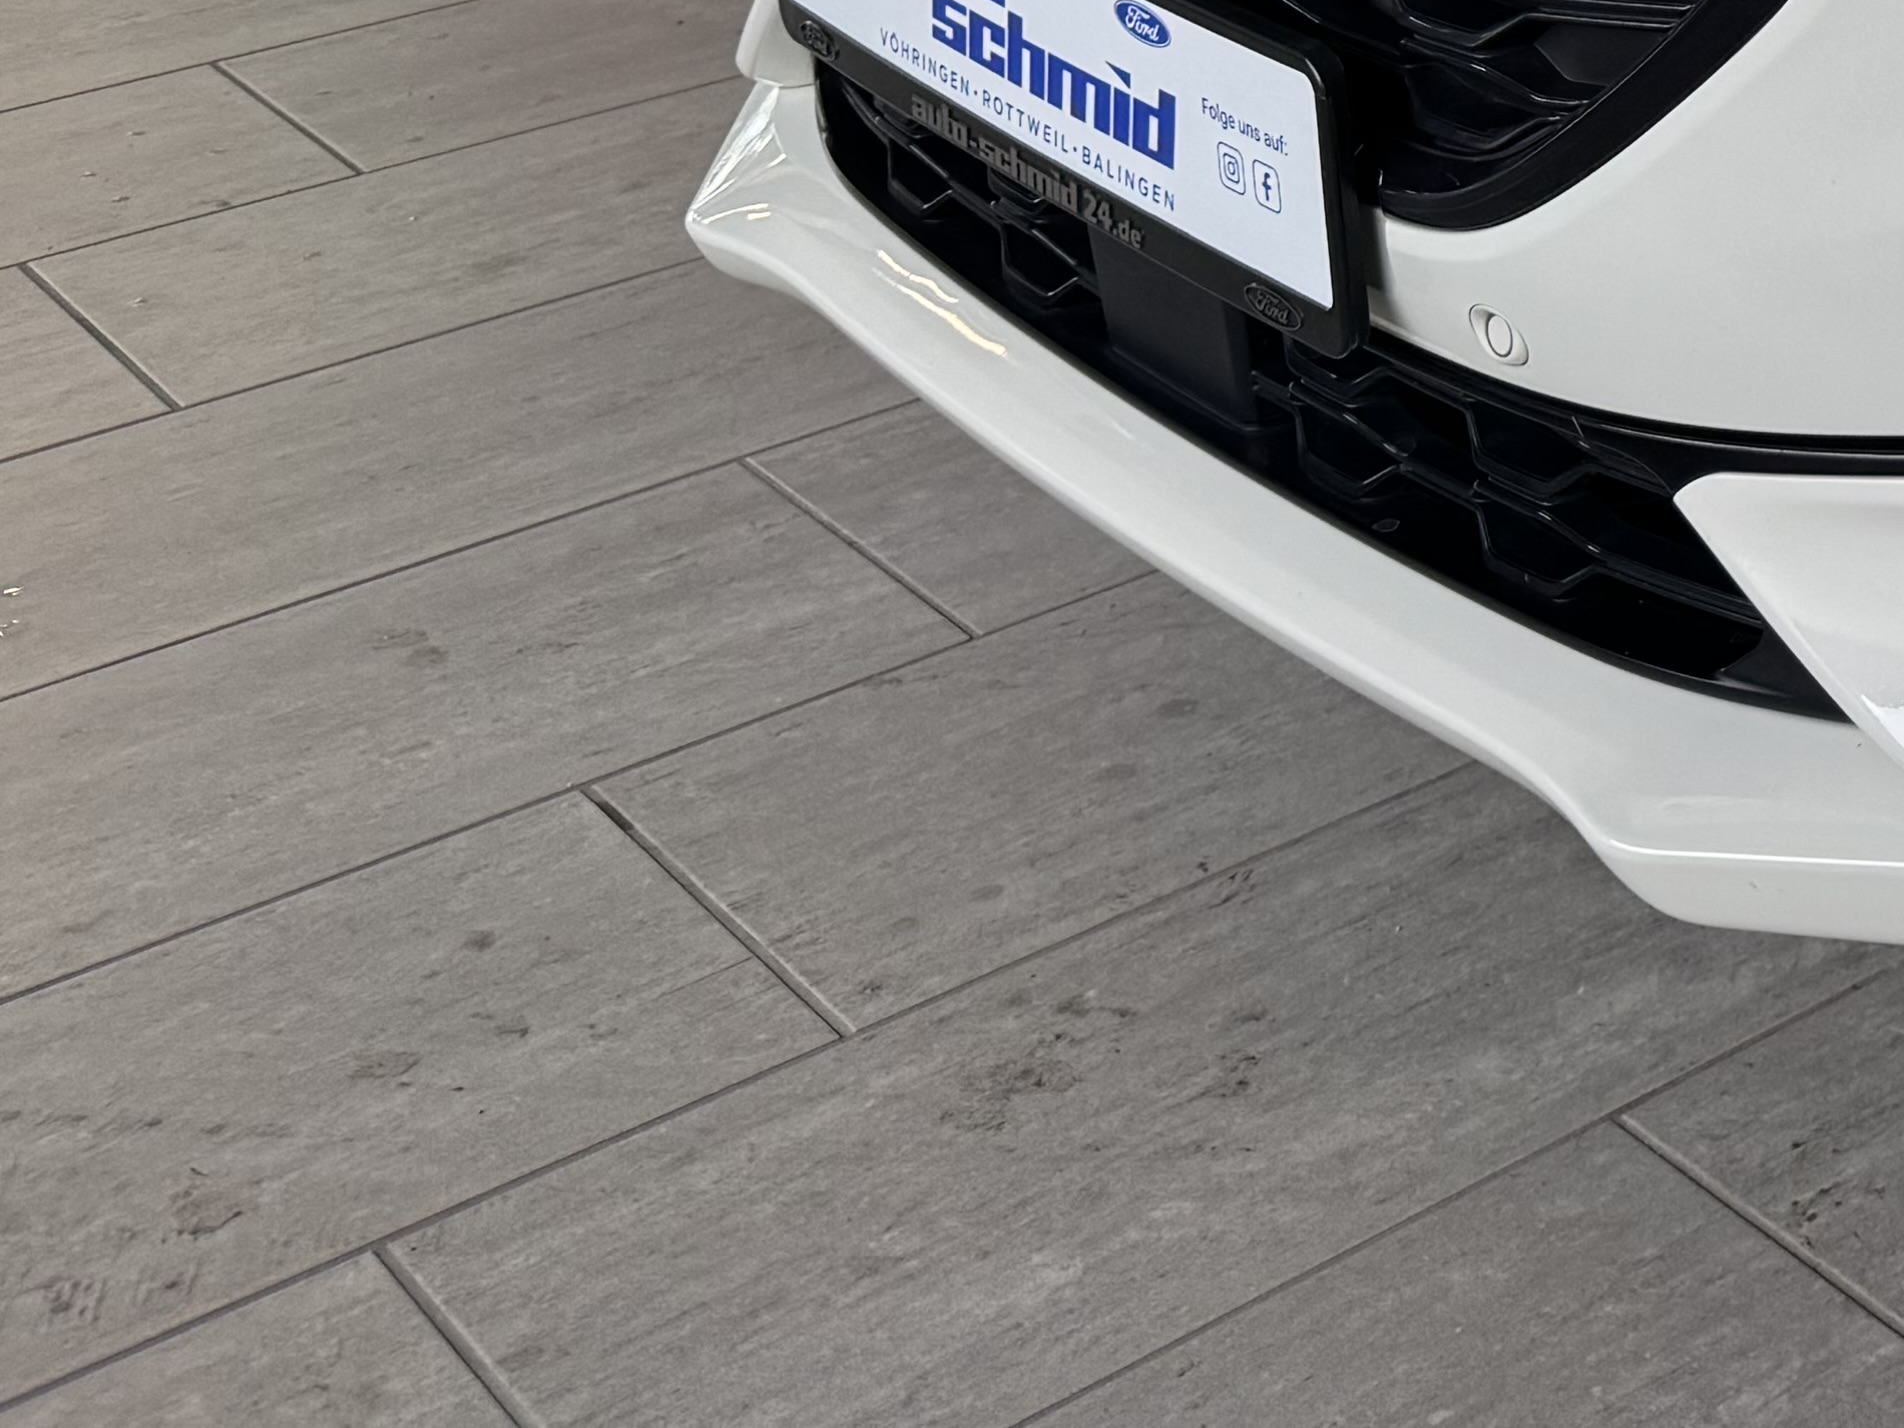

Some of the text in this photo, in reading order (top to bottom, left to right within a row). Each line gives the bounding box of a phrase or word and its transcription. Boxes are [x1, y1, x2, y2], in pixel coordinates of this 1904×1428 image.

[982, 89, 1069, 154] ROTTWEIL
[1082, 145, 1176, 212] BALINGEN
[1201, 96, 1236, 130] Folge
[1238, 119, 1261, 142] uns
